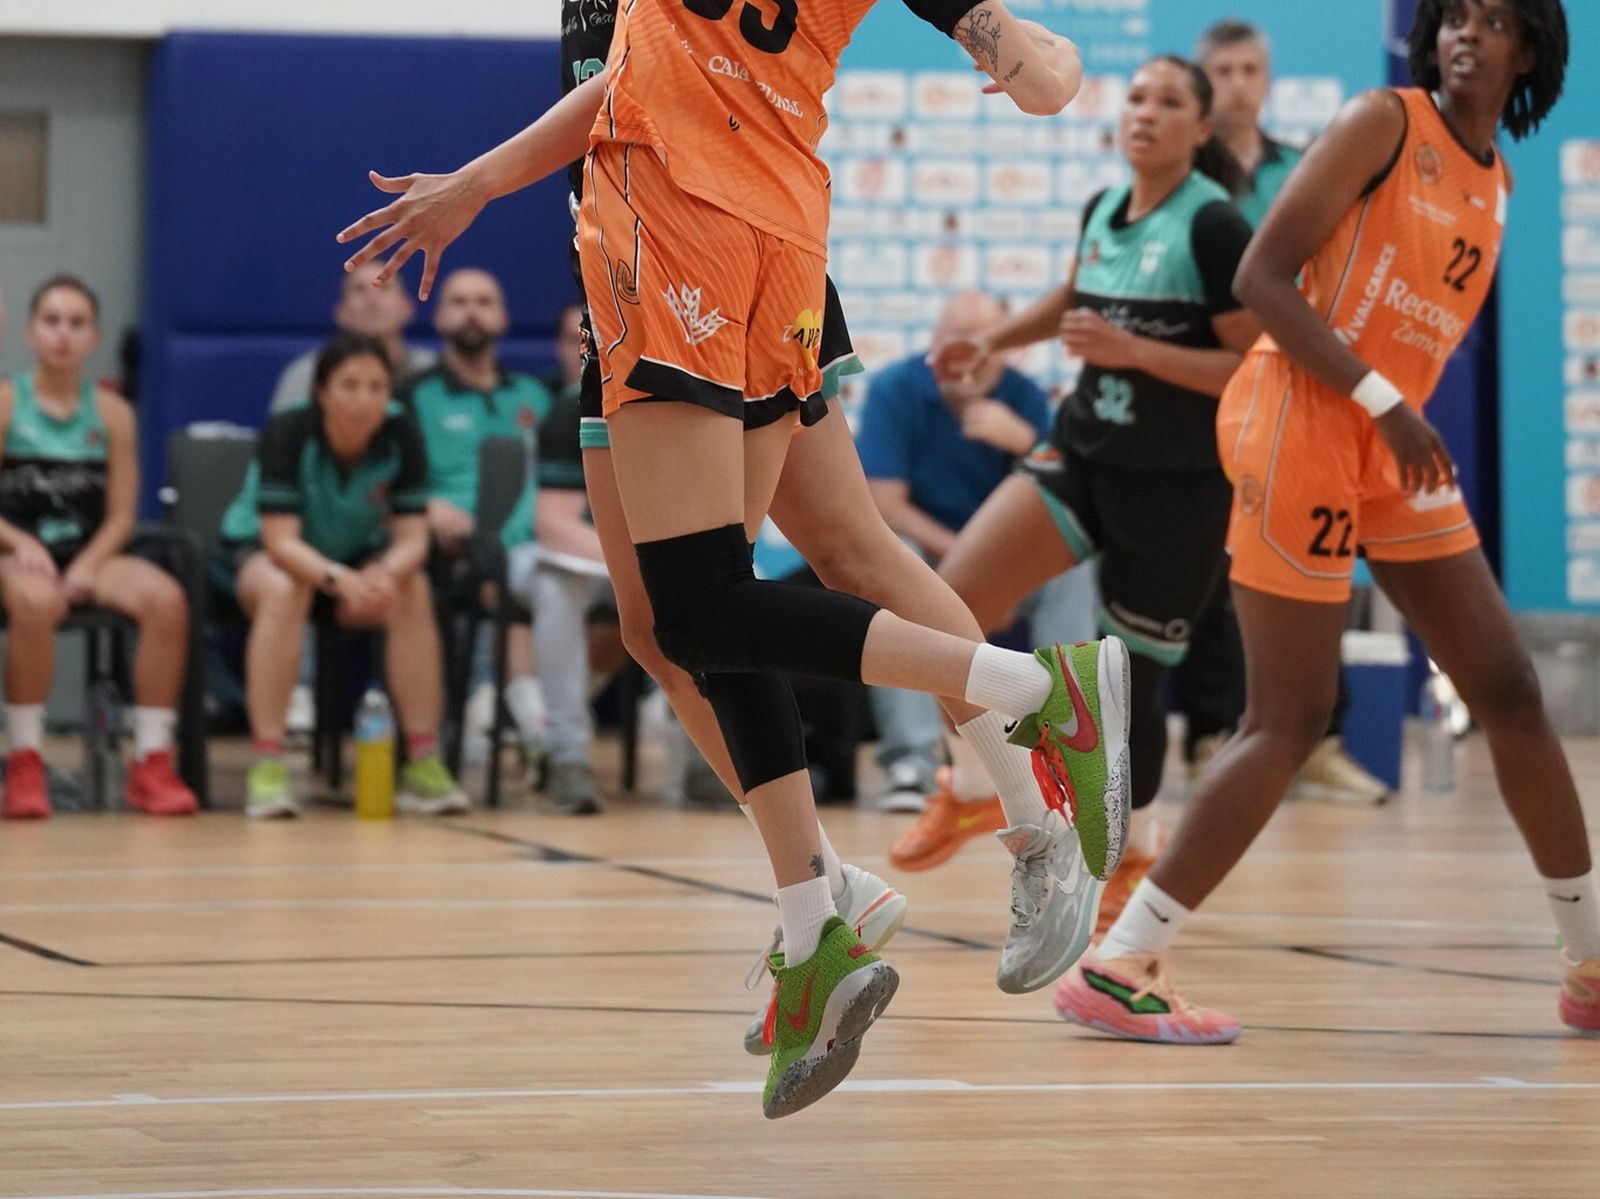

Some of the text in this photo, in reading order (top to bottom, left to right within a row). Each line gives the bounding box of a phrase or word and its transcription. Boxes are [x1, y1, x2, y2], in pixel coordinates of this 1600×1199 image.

[708, 55, 752, 82] CAJA
[1442, 236, 1482, 292] 22
[1093, 374, 1135, 425] 32
[1309, 506, 1353, 558] 22
